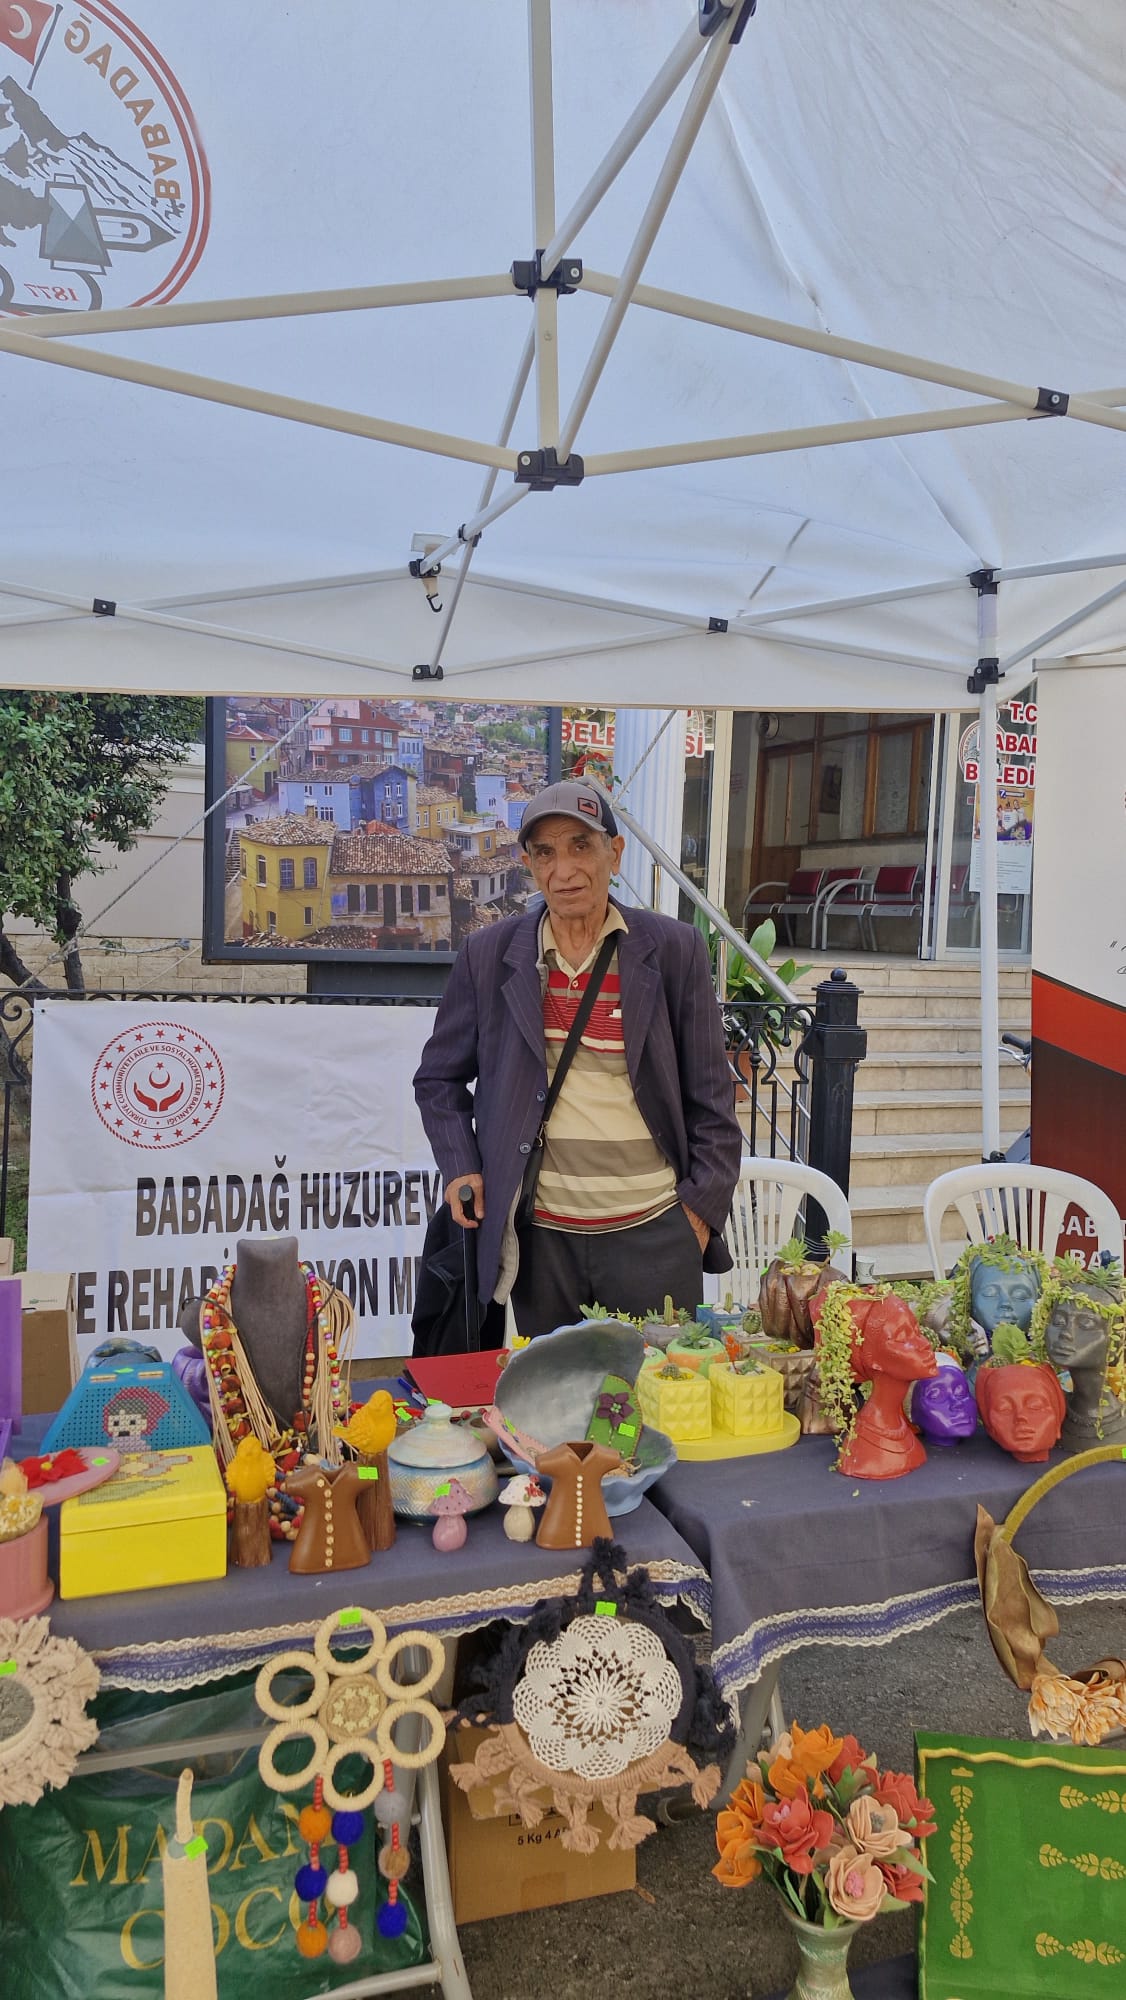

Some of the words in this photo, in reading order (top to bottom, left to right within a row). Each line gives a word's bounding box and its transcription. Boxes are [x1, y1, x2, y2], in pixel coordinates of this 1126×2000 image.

[135, 1155, 290, 1236] BABADAĞ
[301, 1170, 444, 1229] HUZUREV
[527, 1832, 542, 1845] Kg
